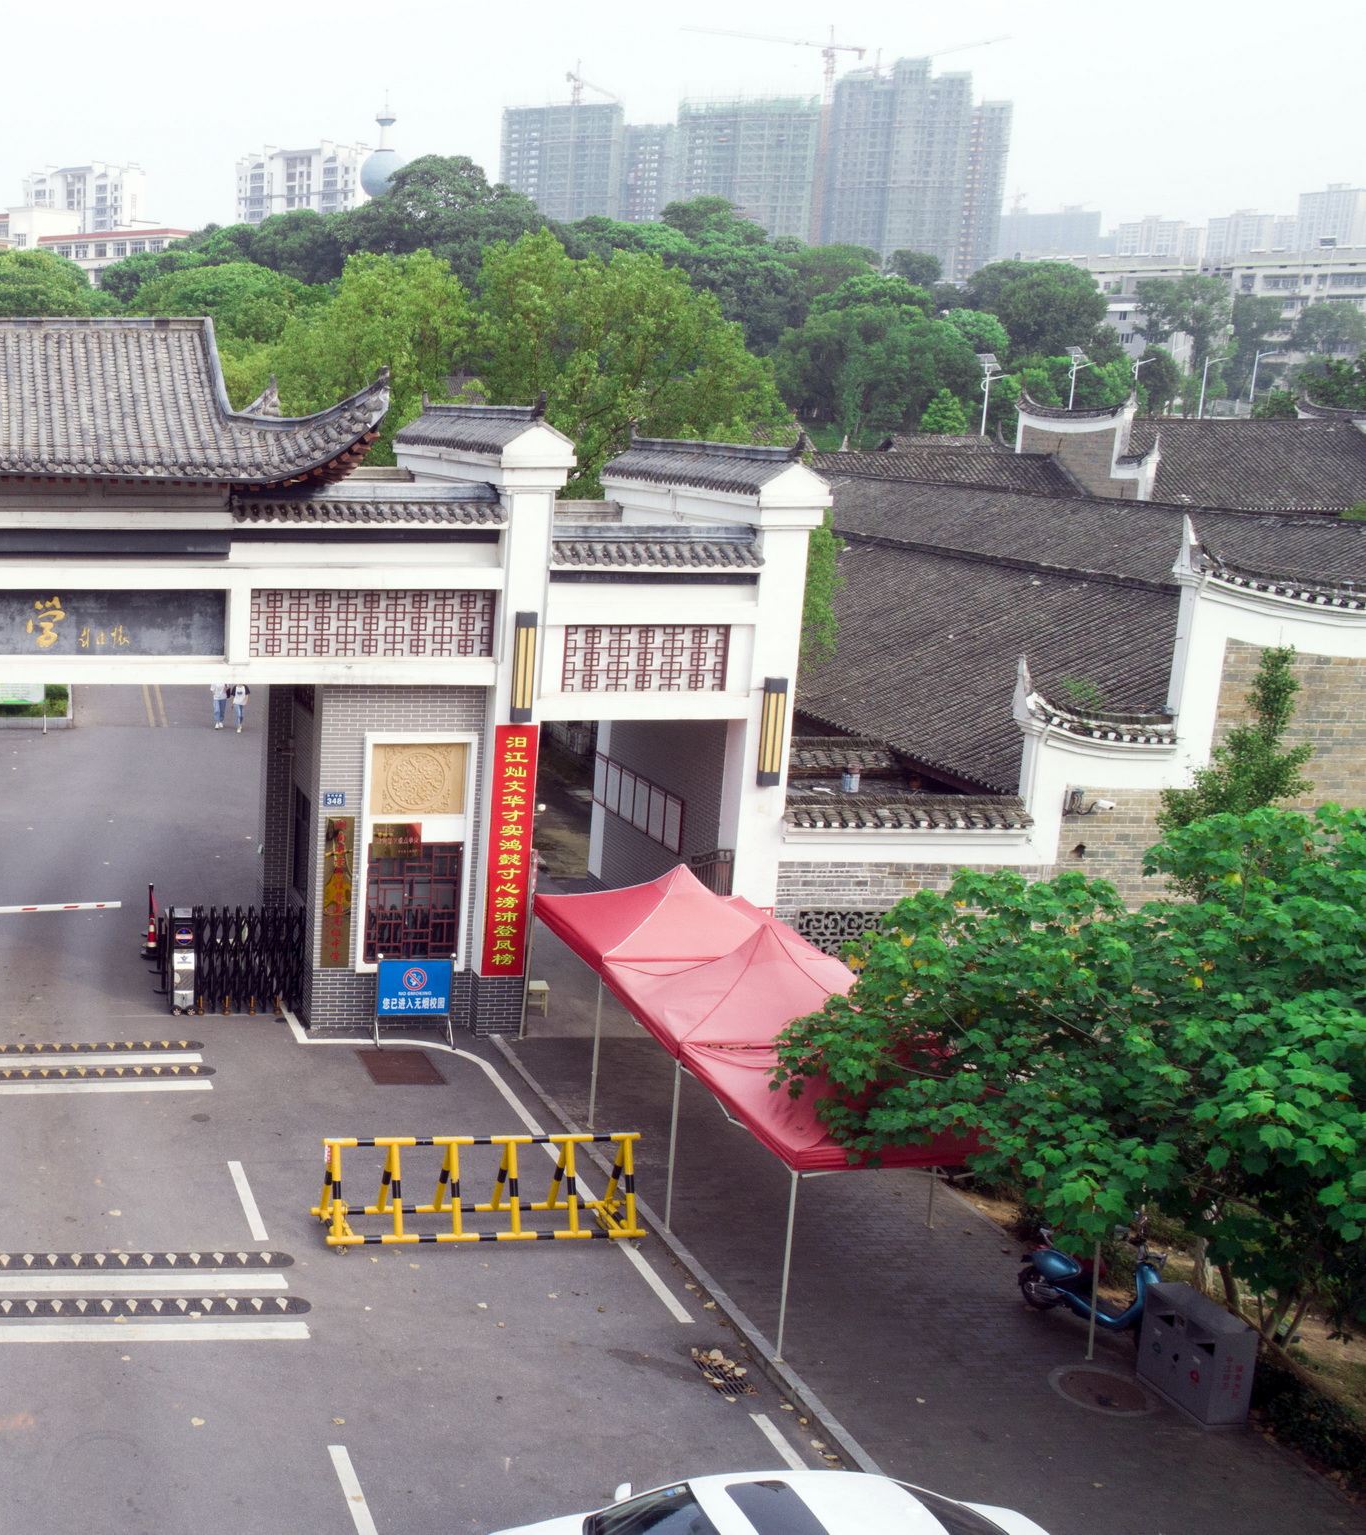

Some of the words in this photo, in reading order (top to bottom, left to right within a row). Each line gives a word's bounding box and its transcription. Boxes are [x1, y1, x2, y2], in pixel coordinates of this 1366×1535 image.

[326, 797, 343, 805] 348
[382, 997, 445, 1010] 您已进入无烟校园
